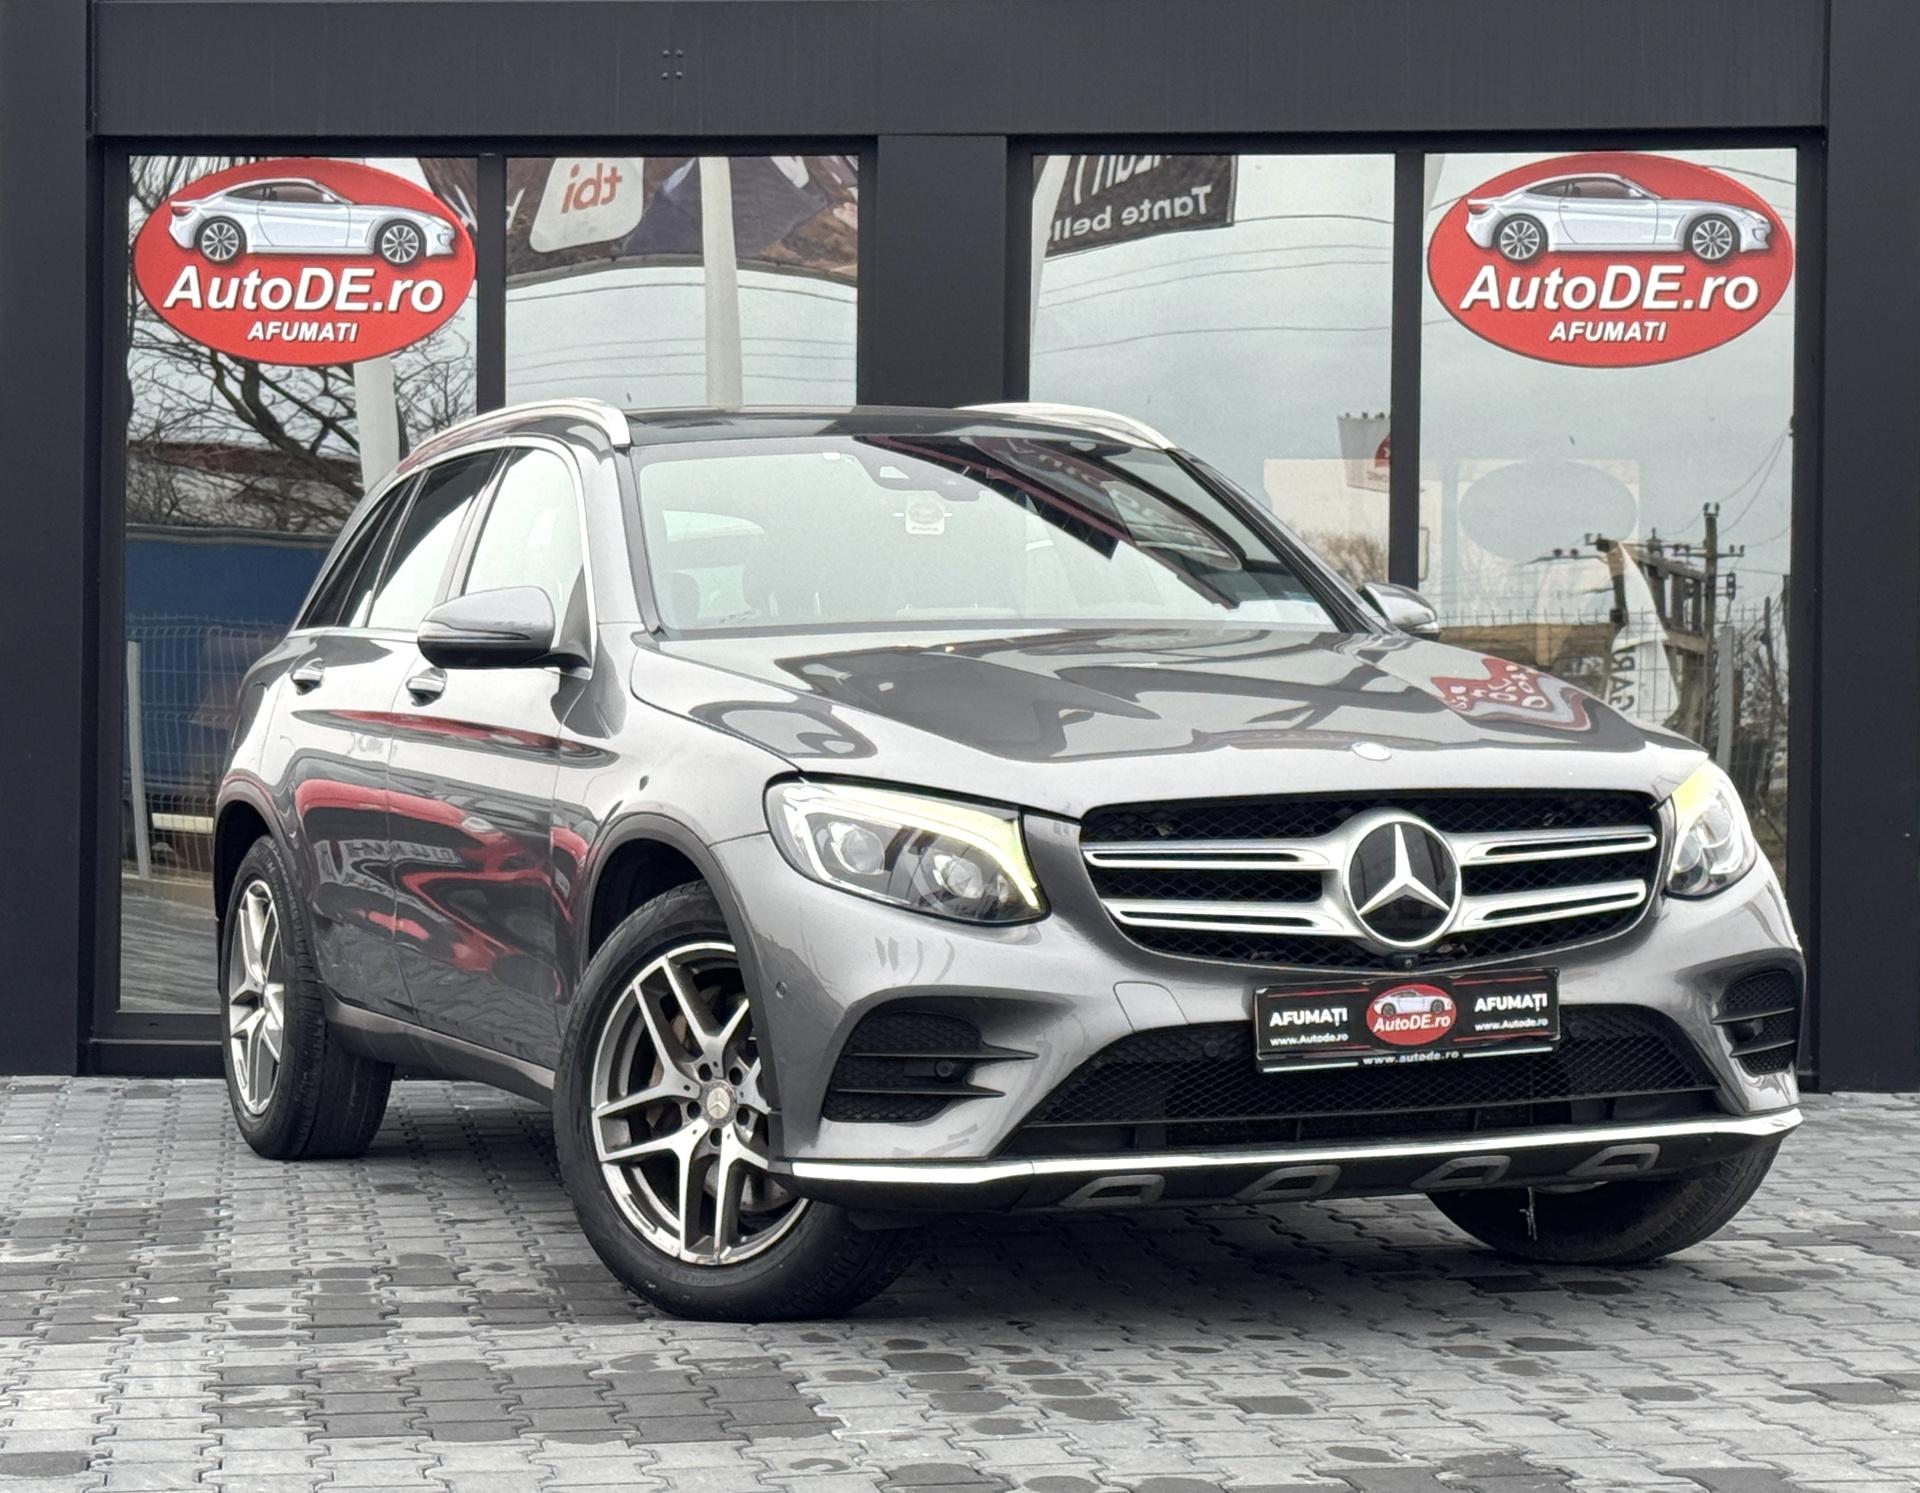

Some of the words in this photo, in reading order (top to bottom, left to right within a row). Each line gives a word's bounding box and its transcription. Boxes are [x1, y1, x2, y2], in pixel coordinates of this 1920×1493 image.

[163, 265, 445, 313] AutoDE.ro
[1459, 264, 1760, 311] AutoDE.ro
[247, 321, 358, 343] AFUMATI
[1548, 321, 1668, 342] AFUMATI
[1373, 1013, 1451, 1034] AutoDE.ro
[1474, 1018, 1549, 1032] www.Autode.ro
[1269, 1033, 1349, 1047] www.Autode.ro
[1362, 1050, 1460, 1065] www.autode.ro
